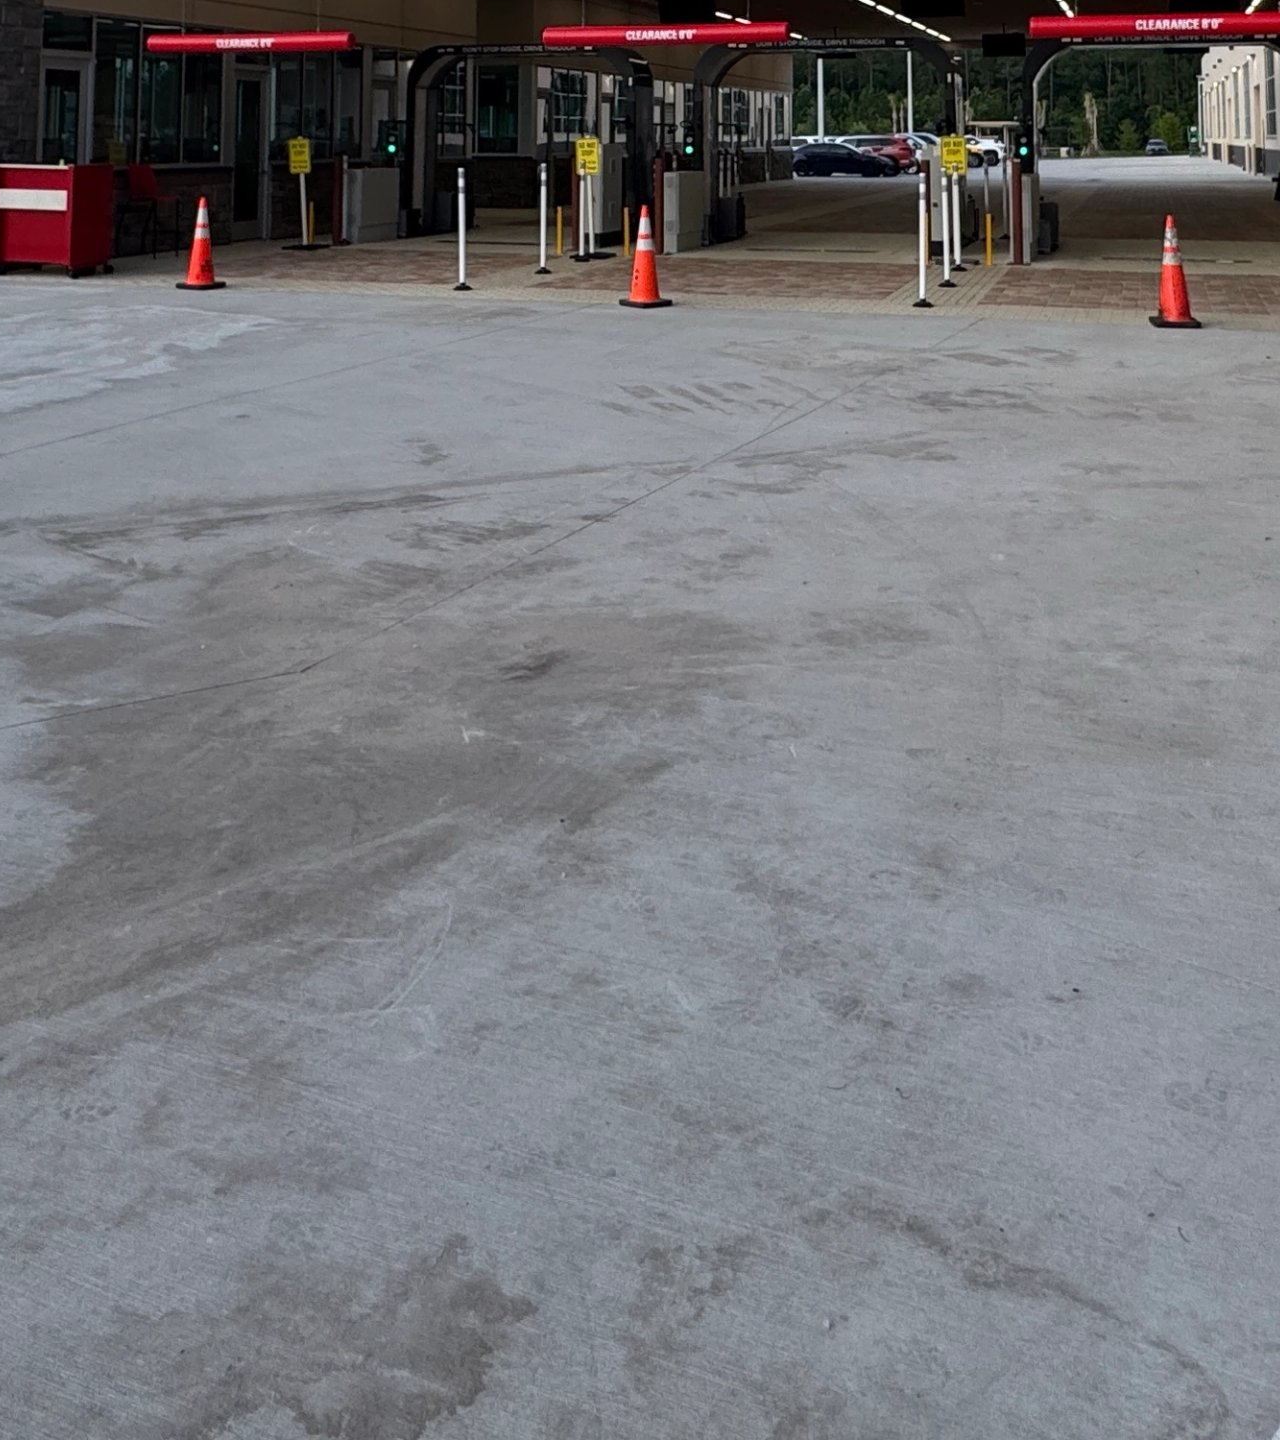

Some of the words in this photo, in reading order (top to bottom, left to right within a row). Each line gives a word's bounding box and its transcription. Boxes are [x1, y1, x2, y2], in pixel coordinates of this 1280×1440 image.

[1135, 19, 1200, 30] CLEARANCE
[625, 29, 677, 40] CLEARANCE
[216, 38, 259, 48] CLEARANCE
